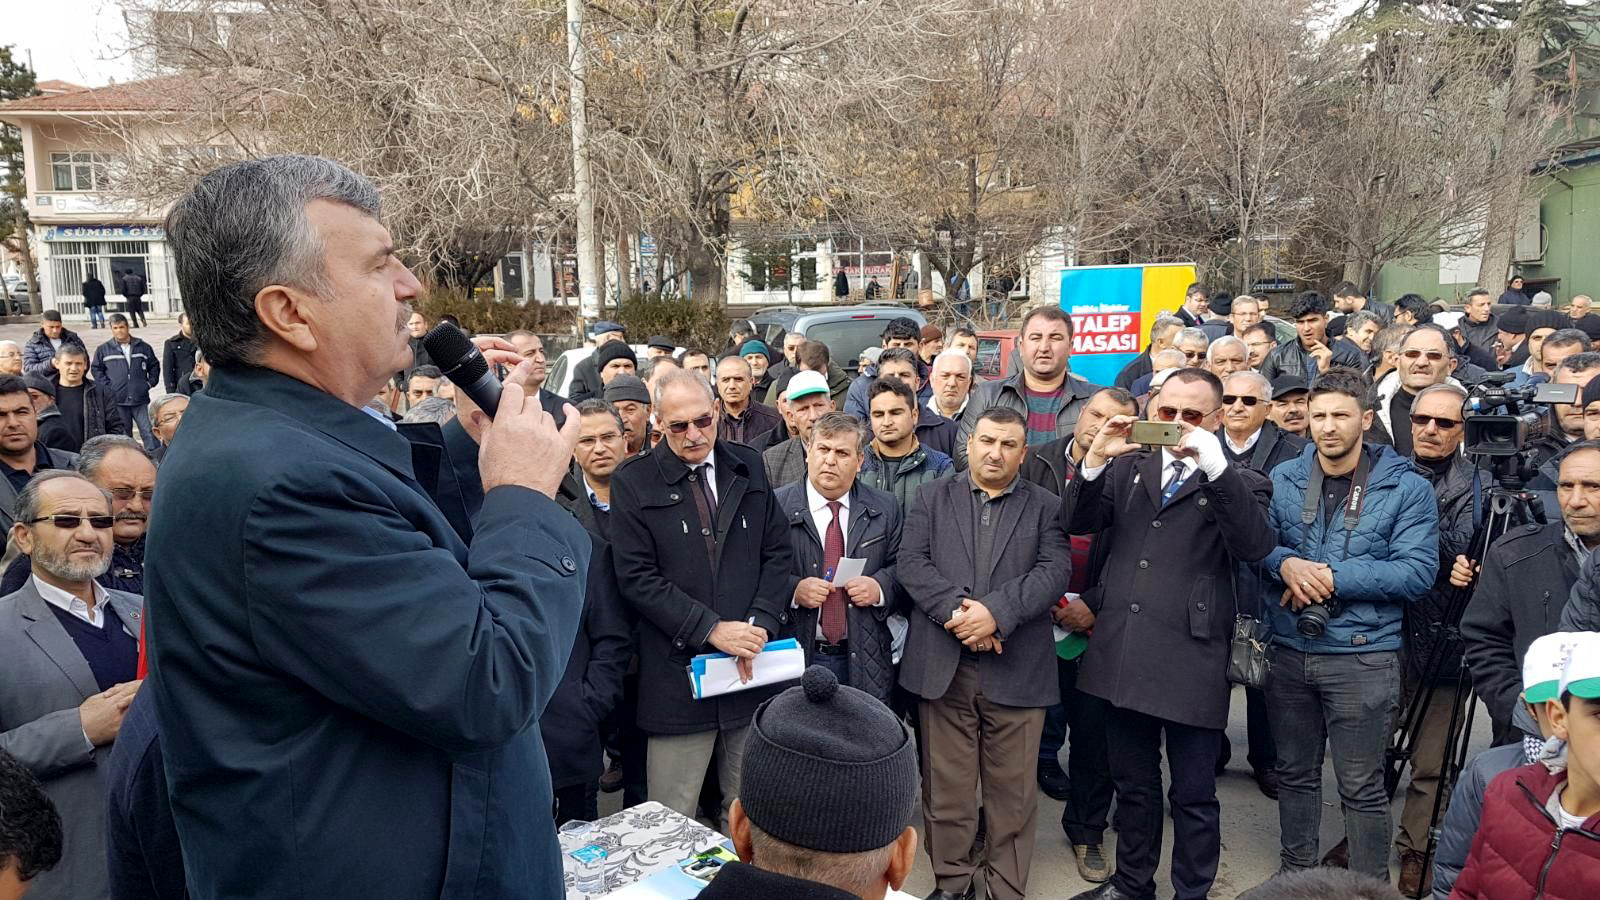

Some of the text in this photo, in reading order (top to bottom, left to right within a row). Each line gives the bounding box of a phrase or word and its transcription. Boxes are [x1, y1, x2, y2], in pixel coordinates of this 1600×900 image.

[63, 227, 124, 237] SÜMER
[1070, 314, 1132, 333] TALEP
[1350, 485, 1362, 511] Canon
